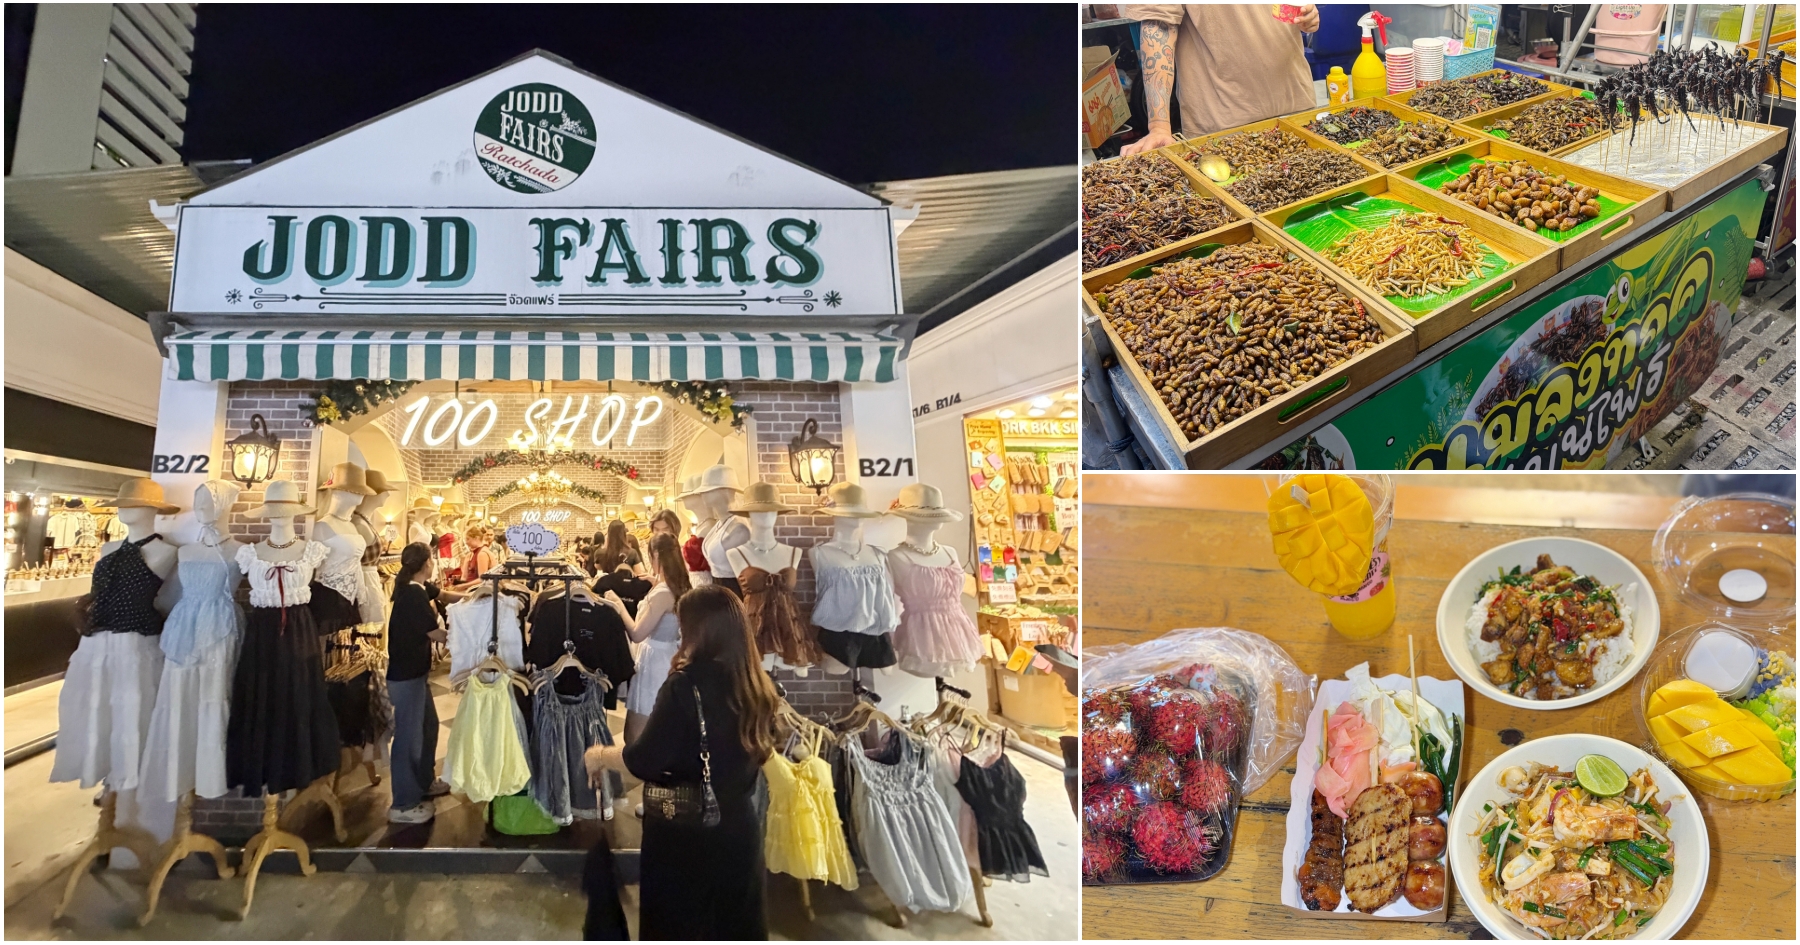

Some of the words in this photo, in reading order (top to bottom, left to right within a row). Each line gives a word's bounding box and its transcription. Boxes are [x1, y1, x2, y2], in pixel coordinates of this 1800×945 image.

[500, 90, 564, 114] JODD
[499, 111, 565, 163] FAIRS
[480, 142, 562, 184] Ratchada
[242, 214, 476, 288] JODD
[529, 216, 826, 289] FAIRS
[935, 392, 962, 411] B1/4
[399, 395, 498, 447] 100
[512, 394, 664, 447] SHOP
[1031, 421, 1060, 434] BKK
[152, 454, 210, 474] B2/2
[858, 457, 914, 477] B2/1
[521, 511, 541, 522] 100
[543, 510, 572, 523] SHOP
[522, 531, 543, 545] 100
